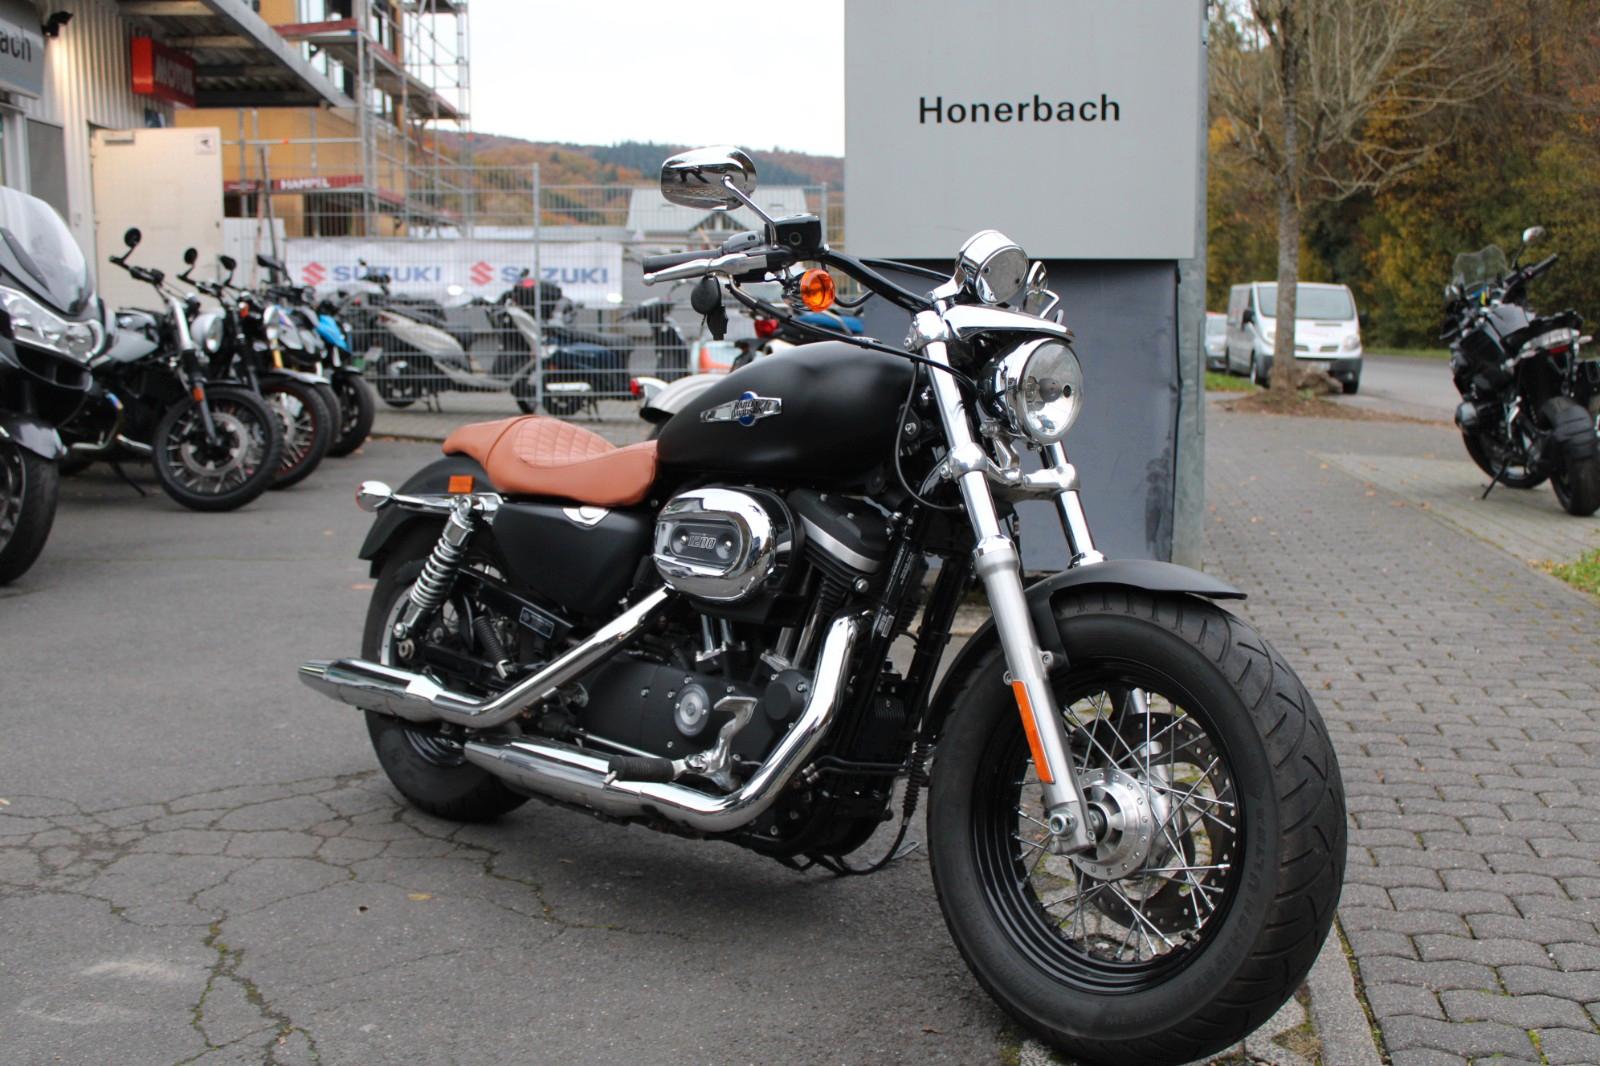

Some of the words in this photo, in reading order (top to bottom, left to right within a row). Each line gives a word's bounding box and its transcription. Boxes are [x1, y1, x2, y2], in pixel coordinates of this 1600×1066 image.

[919, 93, 1120, 124] Honerbach
[500, 266, 609, 284] SZUKI
[688, 535, 717, 550] 1200
